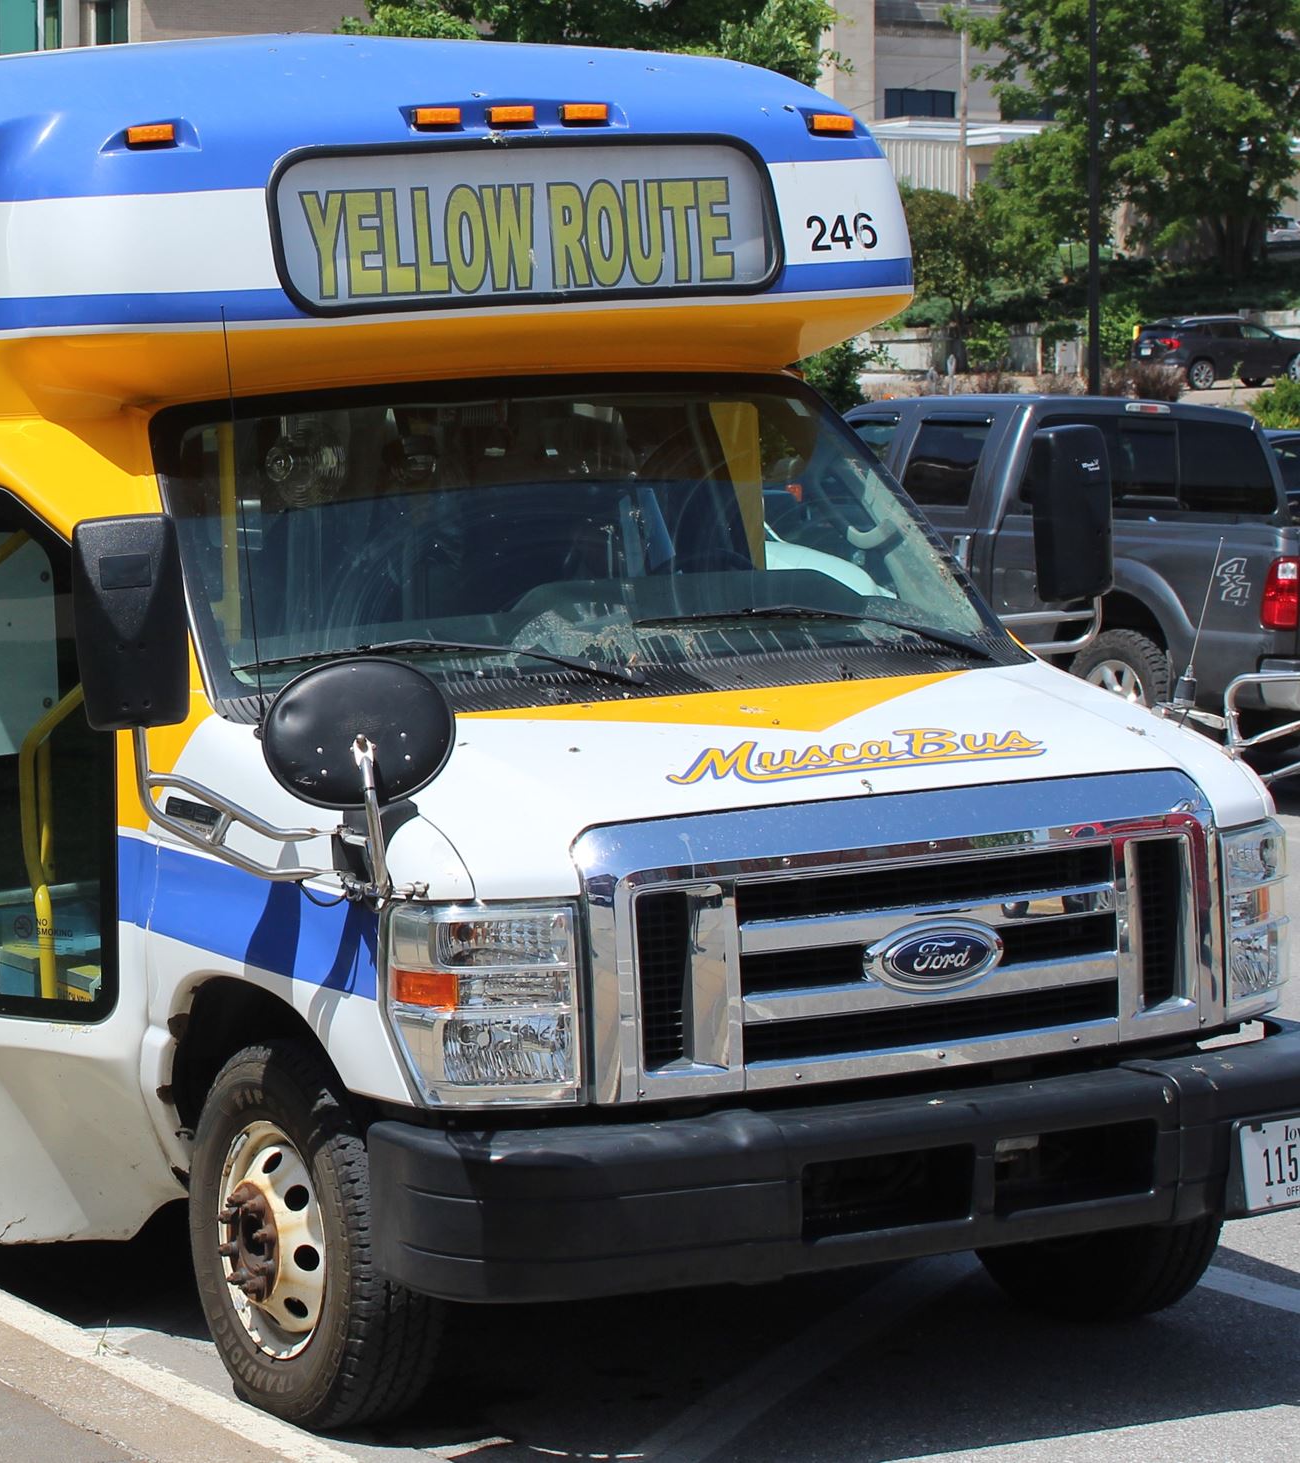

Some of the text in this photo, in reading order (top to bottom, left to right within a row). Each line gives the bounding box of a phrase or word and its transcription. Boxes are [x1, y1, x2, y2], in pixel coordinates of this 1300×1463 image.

[298, 176, 735, 300] YELLOW ROUTE
[806, 212, 878, 252] 246
[36, 918, 48, 926] NO
[36, 928, 73, 937] SMOKING
[913, 940, 971, 972] Ford
[1263, 1143, 1299, 1186] 115
